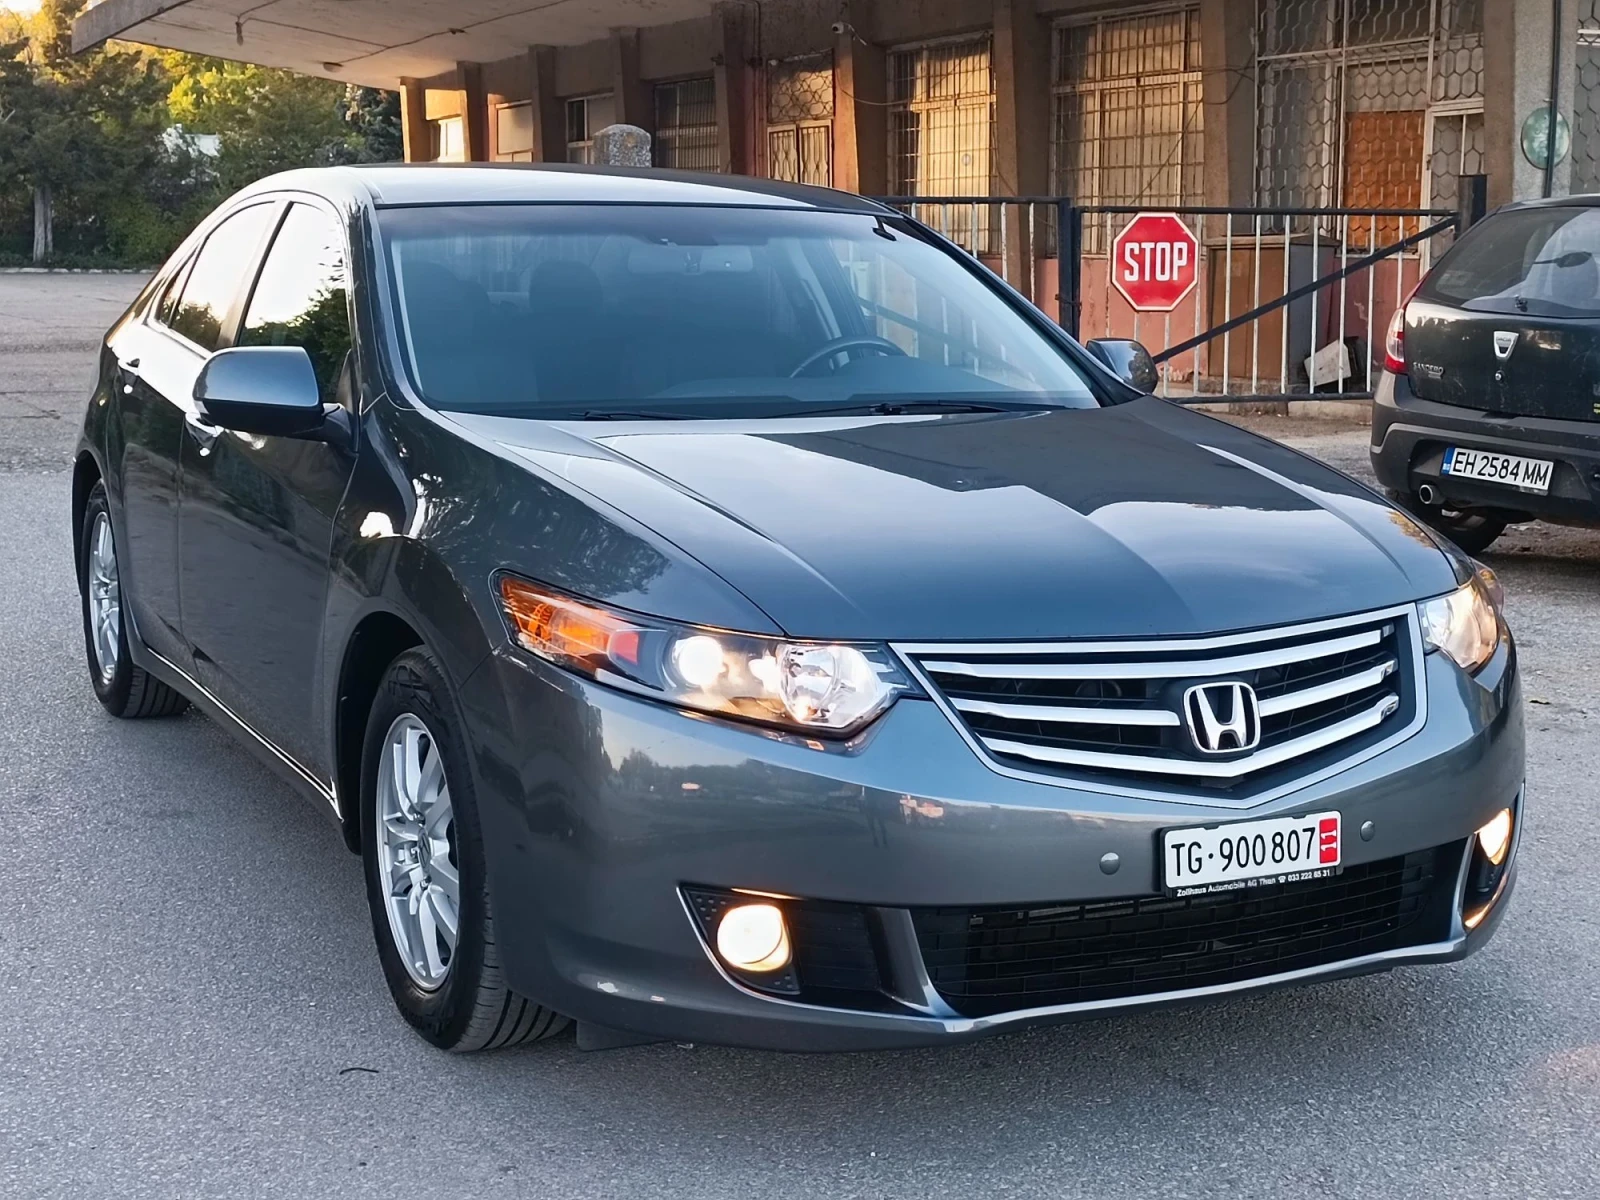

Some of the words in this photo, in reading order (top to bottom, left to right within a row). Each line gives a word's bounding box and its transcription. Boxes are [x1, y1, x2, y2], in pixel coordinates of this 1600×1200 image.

[1124, 242, 1188, 281] STOP
[1453, 452, 1477, 475] EH
[1477, 455, 1521, 482] 2584
[1522, 461, 1549, 486] MM
[1208, 881, 1245, 892] Automobile
[1247, 879, 1257, 888] AG
[1301, 871, 1313, 880] 222
[1322, 868, 1331, 877] 31
